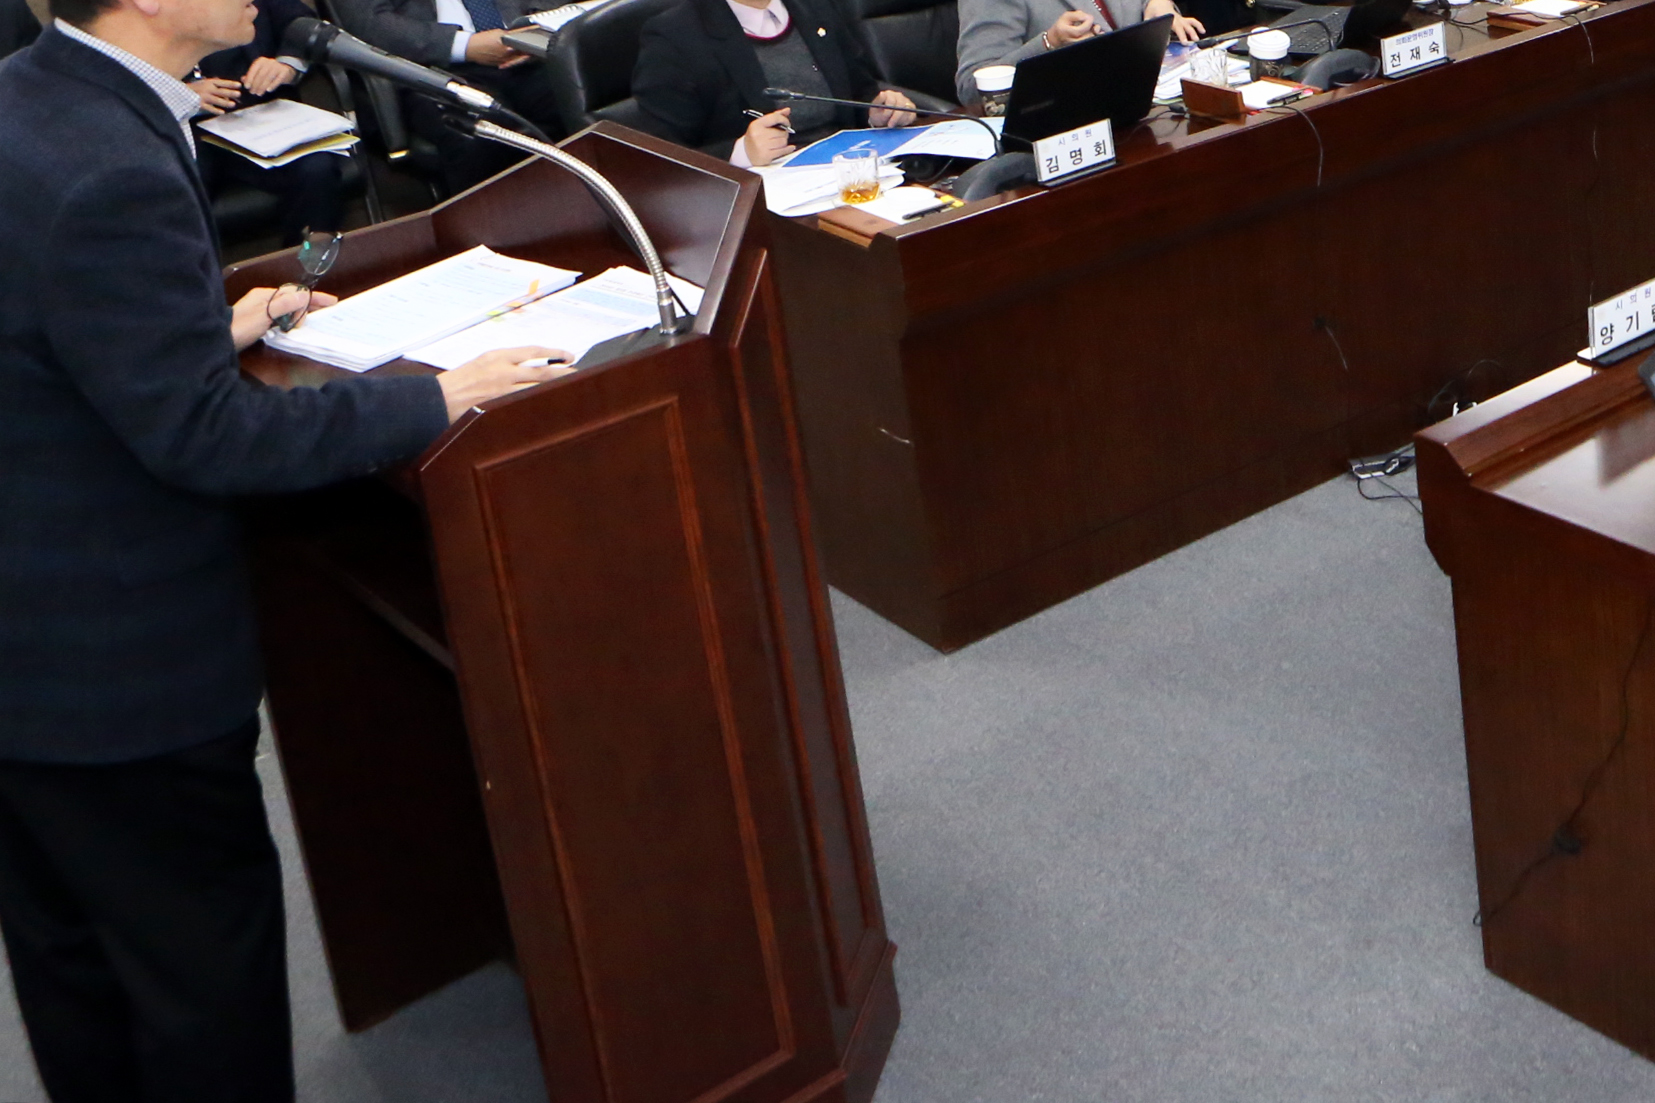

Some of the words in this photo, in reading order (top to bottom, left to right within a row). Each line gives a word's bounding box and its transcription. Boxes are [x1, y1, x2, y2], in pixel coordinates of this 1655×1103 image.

[1390, 41, 1440, 68] 전재숙
[1058, 129, 1093, 146] 시의원
[1046, 139, 1107, 174] 김명회
[1615, 287, 1651, 310] 시의원
